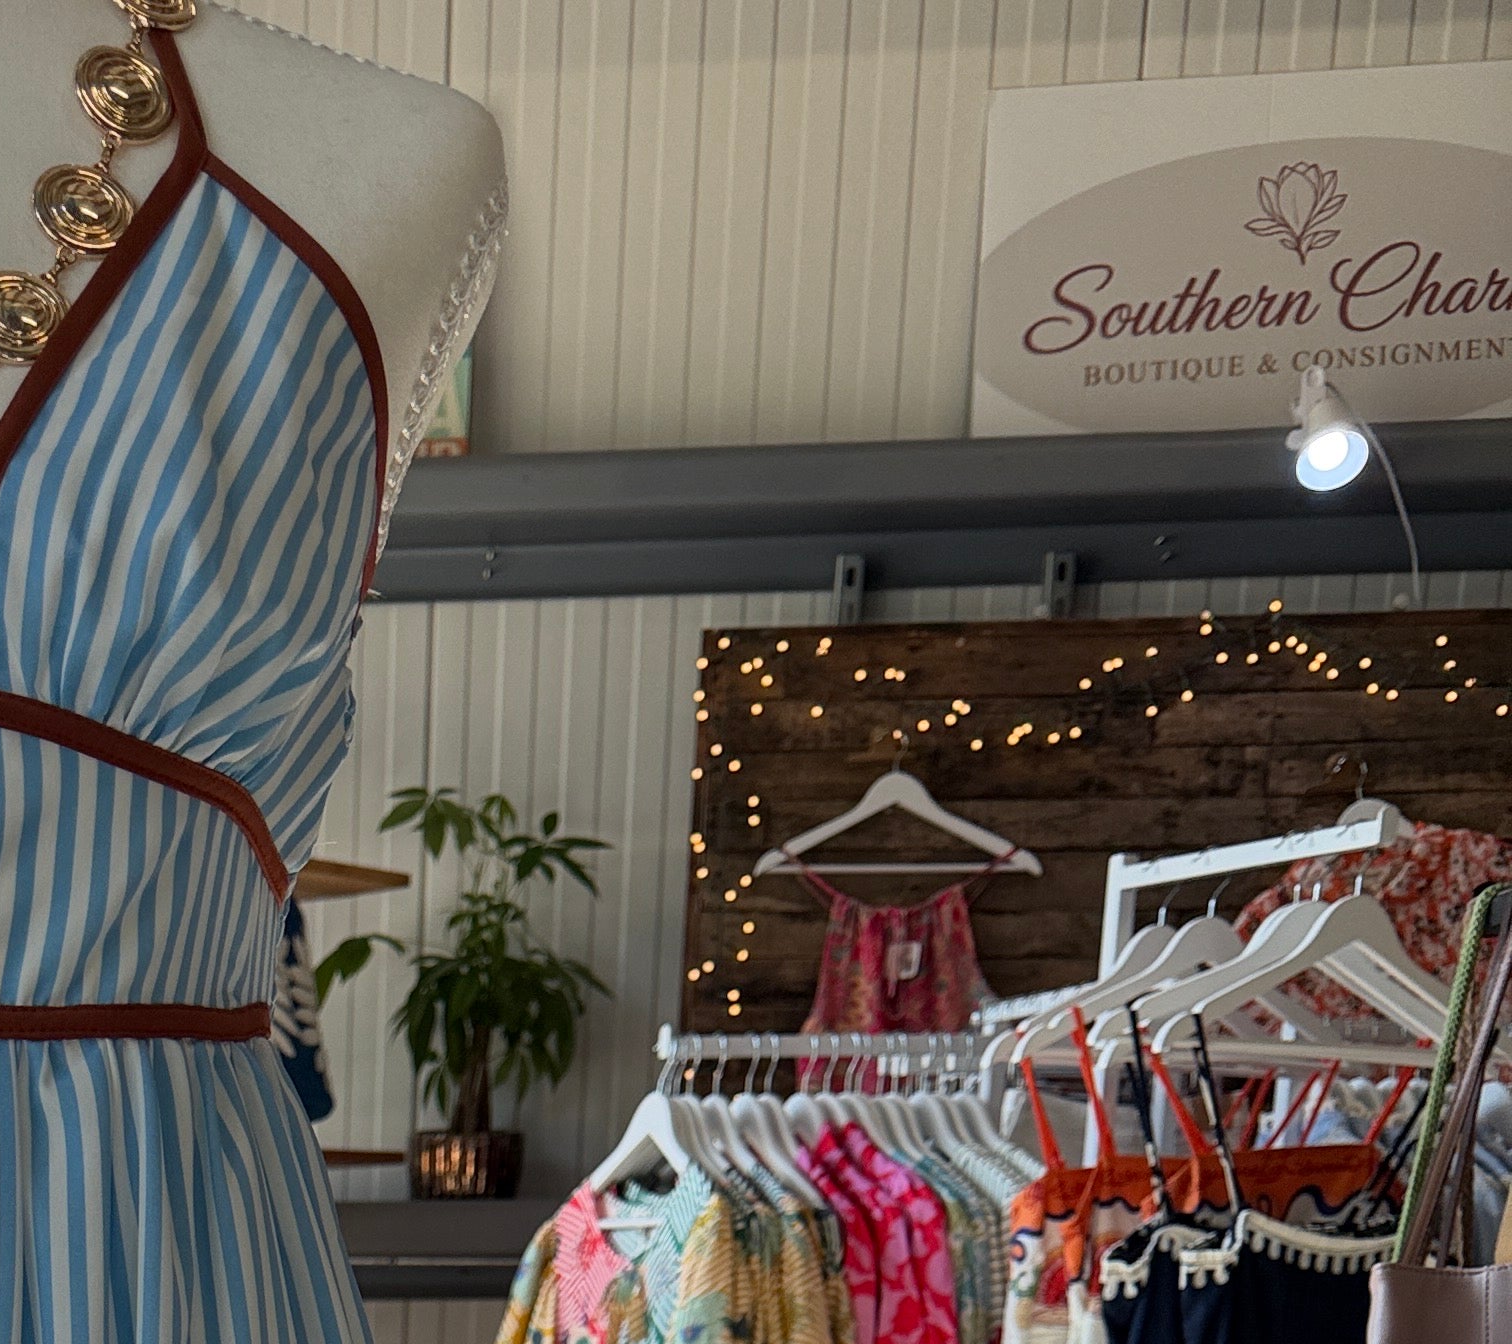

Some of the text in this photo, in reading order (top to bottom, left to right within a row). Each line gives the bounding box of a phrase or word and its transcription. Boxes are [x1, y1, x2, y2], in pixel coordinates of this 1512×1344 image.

[1022, 241, 1512, 355] Southern Char
[1083, 337, 1512, 388] BOUTIQUE & CONSIGNMEN
